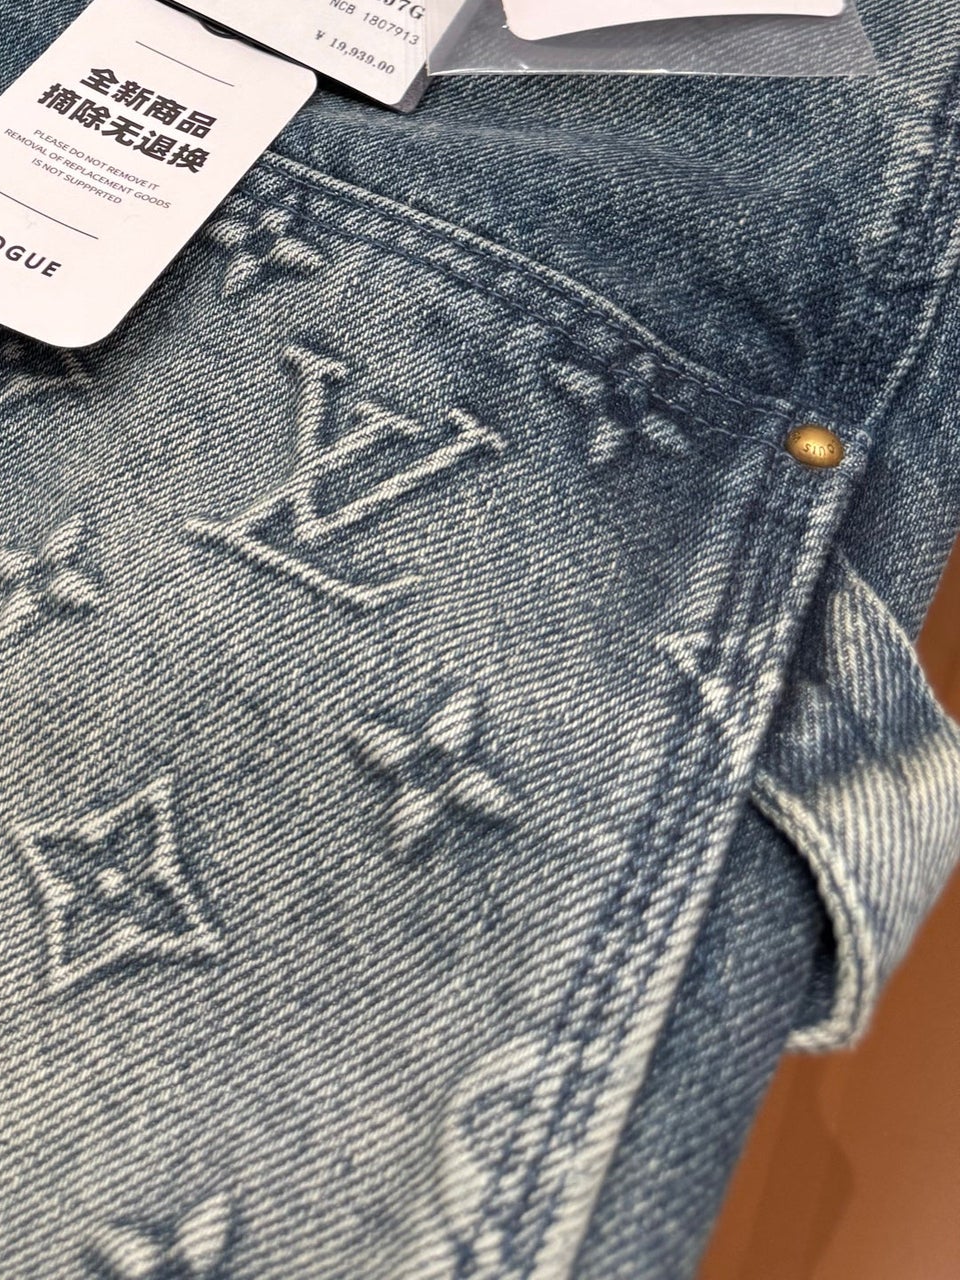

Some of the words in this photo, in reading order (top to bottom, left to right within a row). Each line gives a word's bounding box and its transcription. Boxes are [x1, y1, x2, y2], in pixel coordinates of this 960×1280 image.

[329, 38, 395, 75] 19,939.00
[362, 12, 420, 46] 1807913
[37, 83, 211, 174] 摘除无退换
[79, 68, 218, 140] 全新商品
[4, 128, 48, 156] REMOVAL
[49, 152, 64, 163] OF
[62, 159, 133, 195] REPLACEMENT
[133, 191, 172, 209] GOODS
[31, 158, 42, 167] IS
[42, 163, 65, 177] NOT
[33, 129, 70, 152] PLEASE
[68, 148, 85, 159] DO
[85, 155, 108, 169] NOT
[107, 165, 148, 187] REMOVE
[148, 183, 160, 191] IT
